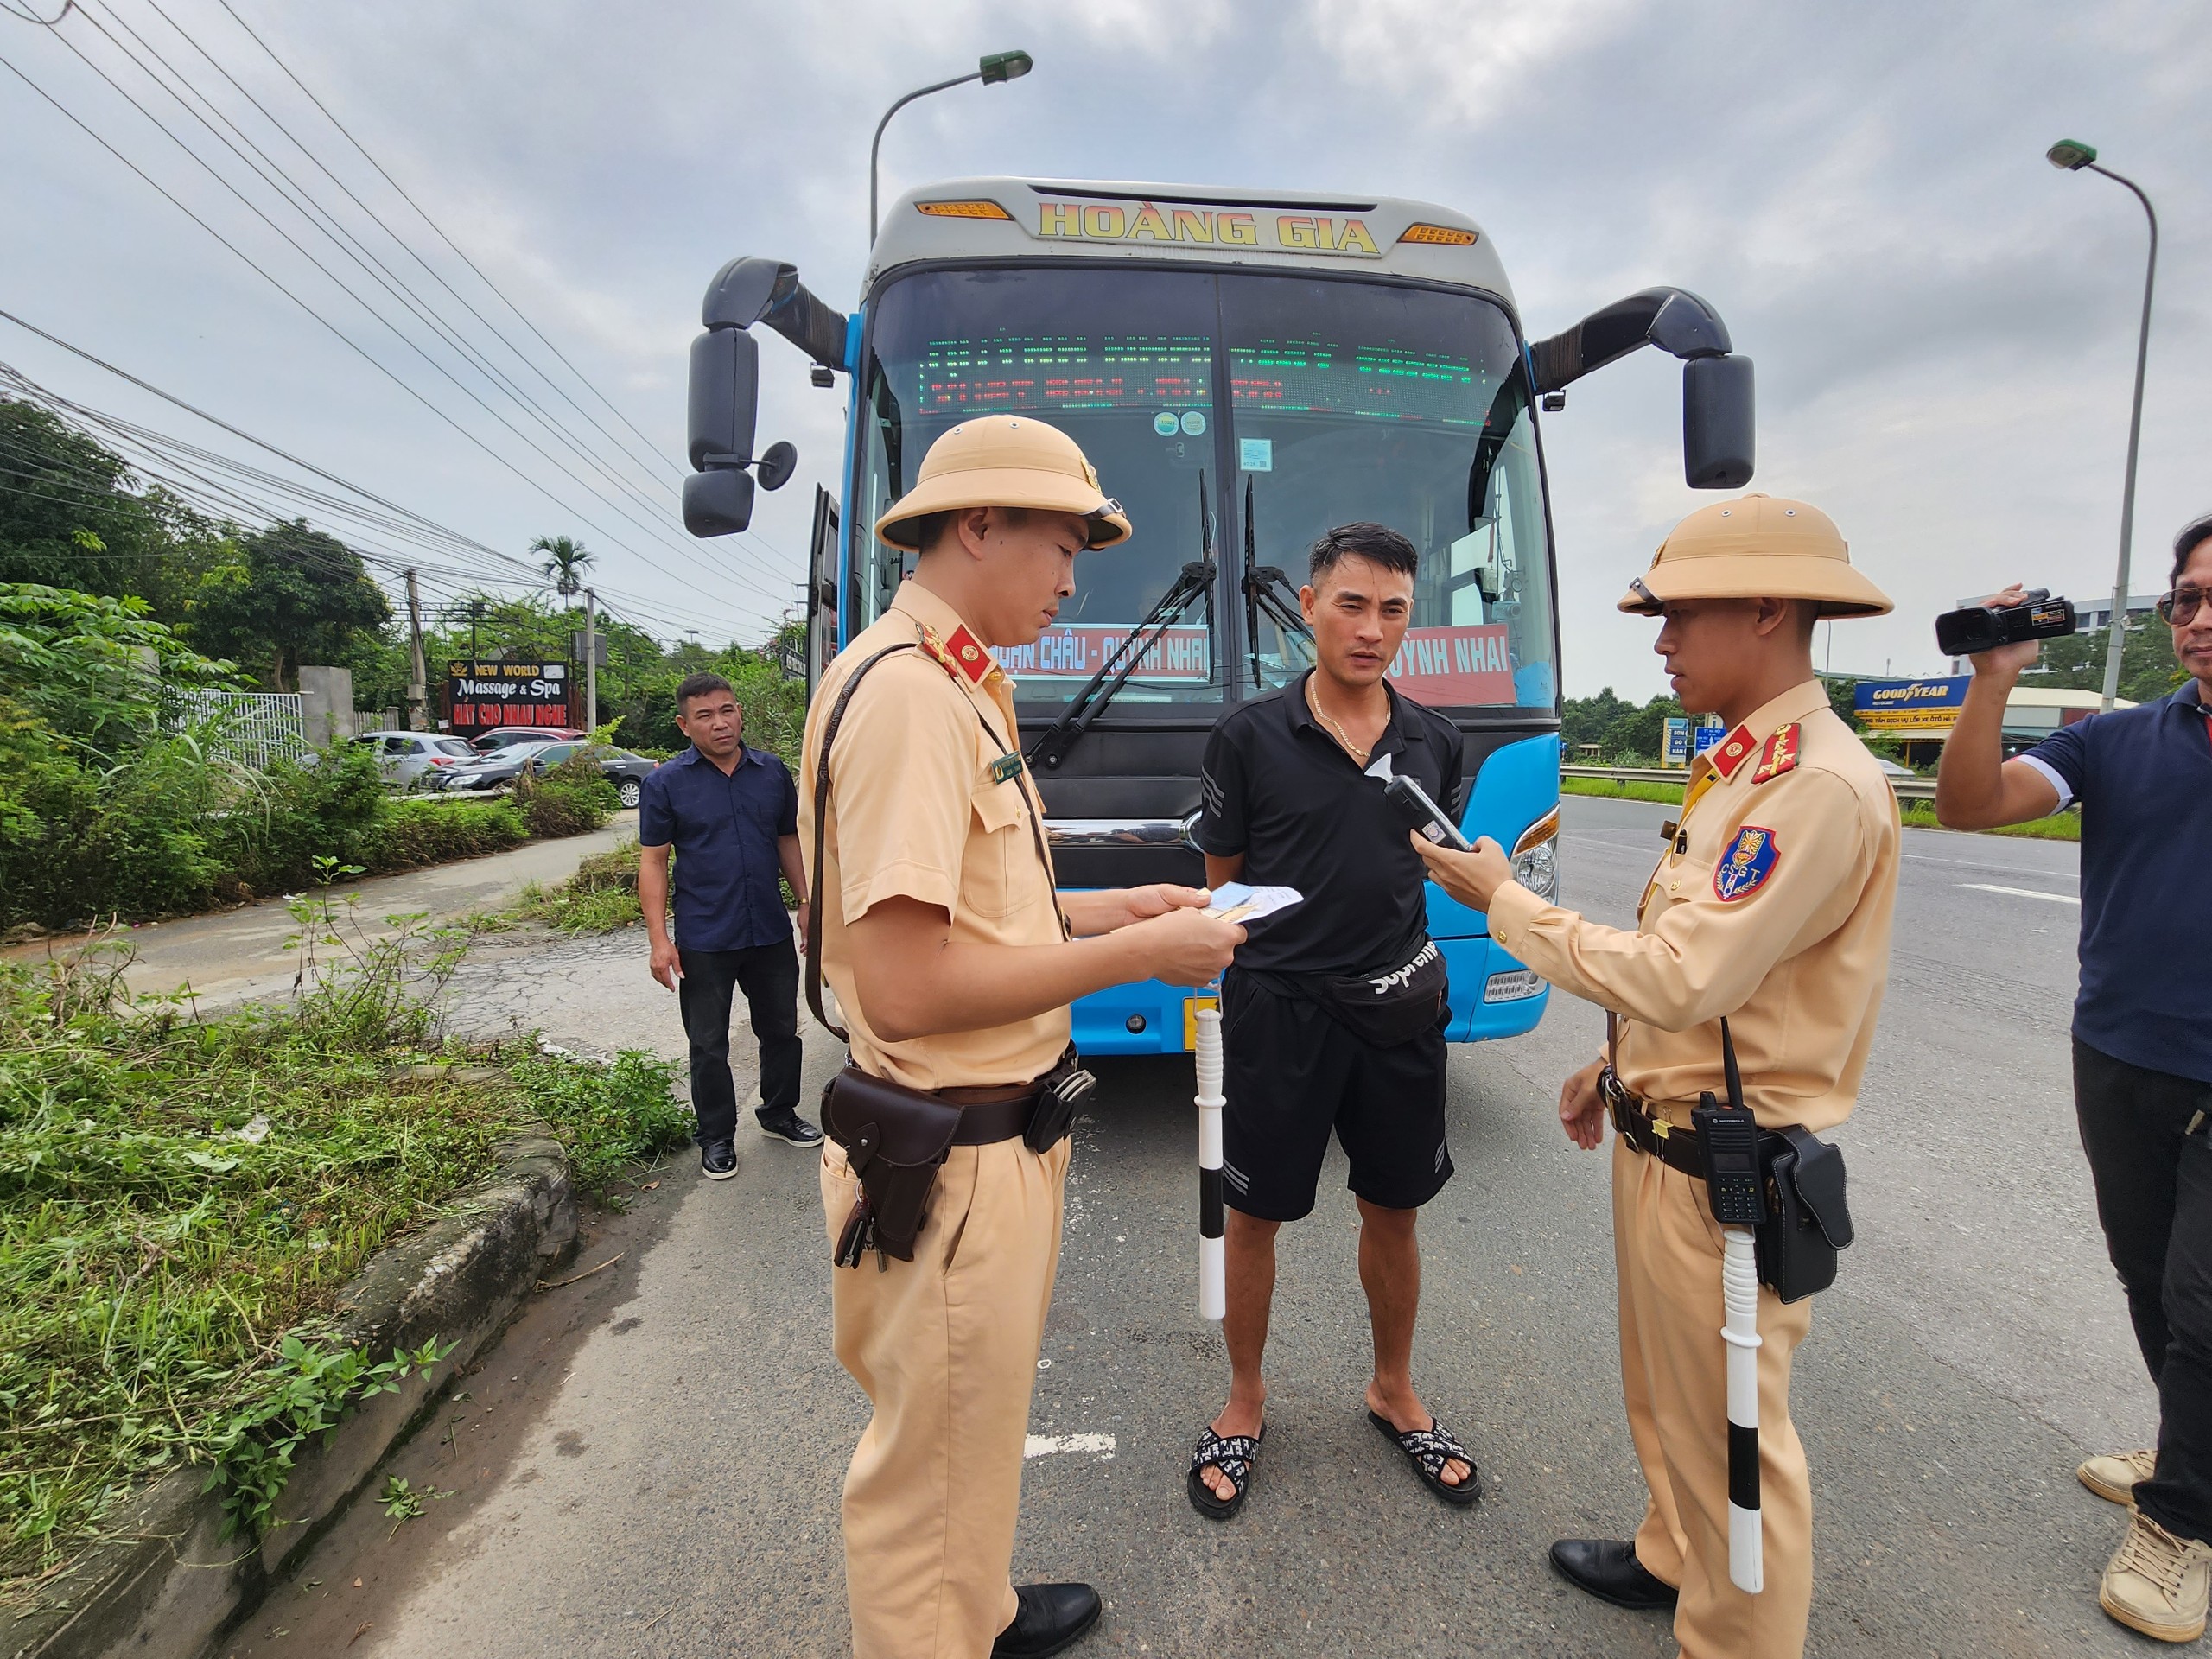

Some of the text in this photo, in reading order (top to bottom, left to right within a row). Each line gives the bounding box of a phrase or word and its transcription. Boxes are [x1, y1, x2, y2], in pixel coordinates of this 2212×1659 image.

[1039, 201, 1382, 254] HOÀNG GIA
[1039, 628, 1086, 670] CHÂU
[1383, 632, 1508, 678] UỲNH NHAI
[474, 664, 540, 677] NEW WORLD
[457, 678, 561, 699] Massage & Spa
[1872, 683, 1949, 702] GOODYEAR
[454, 696, 567, 726] HÁT CHO NHAU NGHE
[1721, 863, 1761, 880] CSGT
